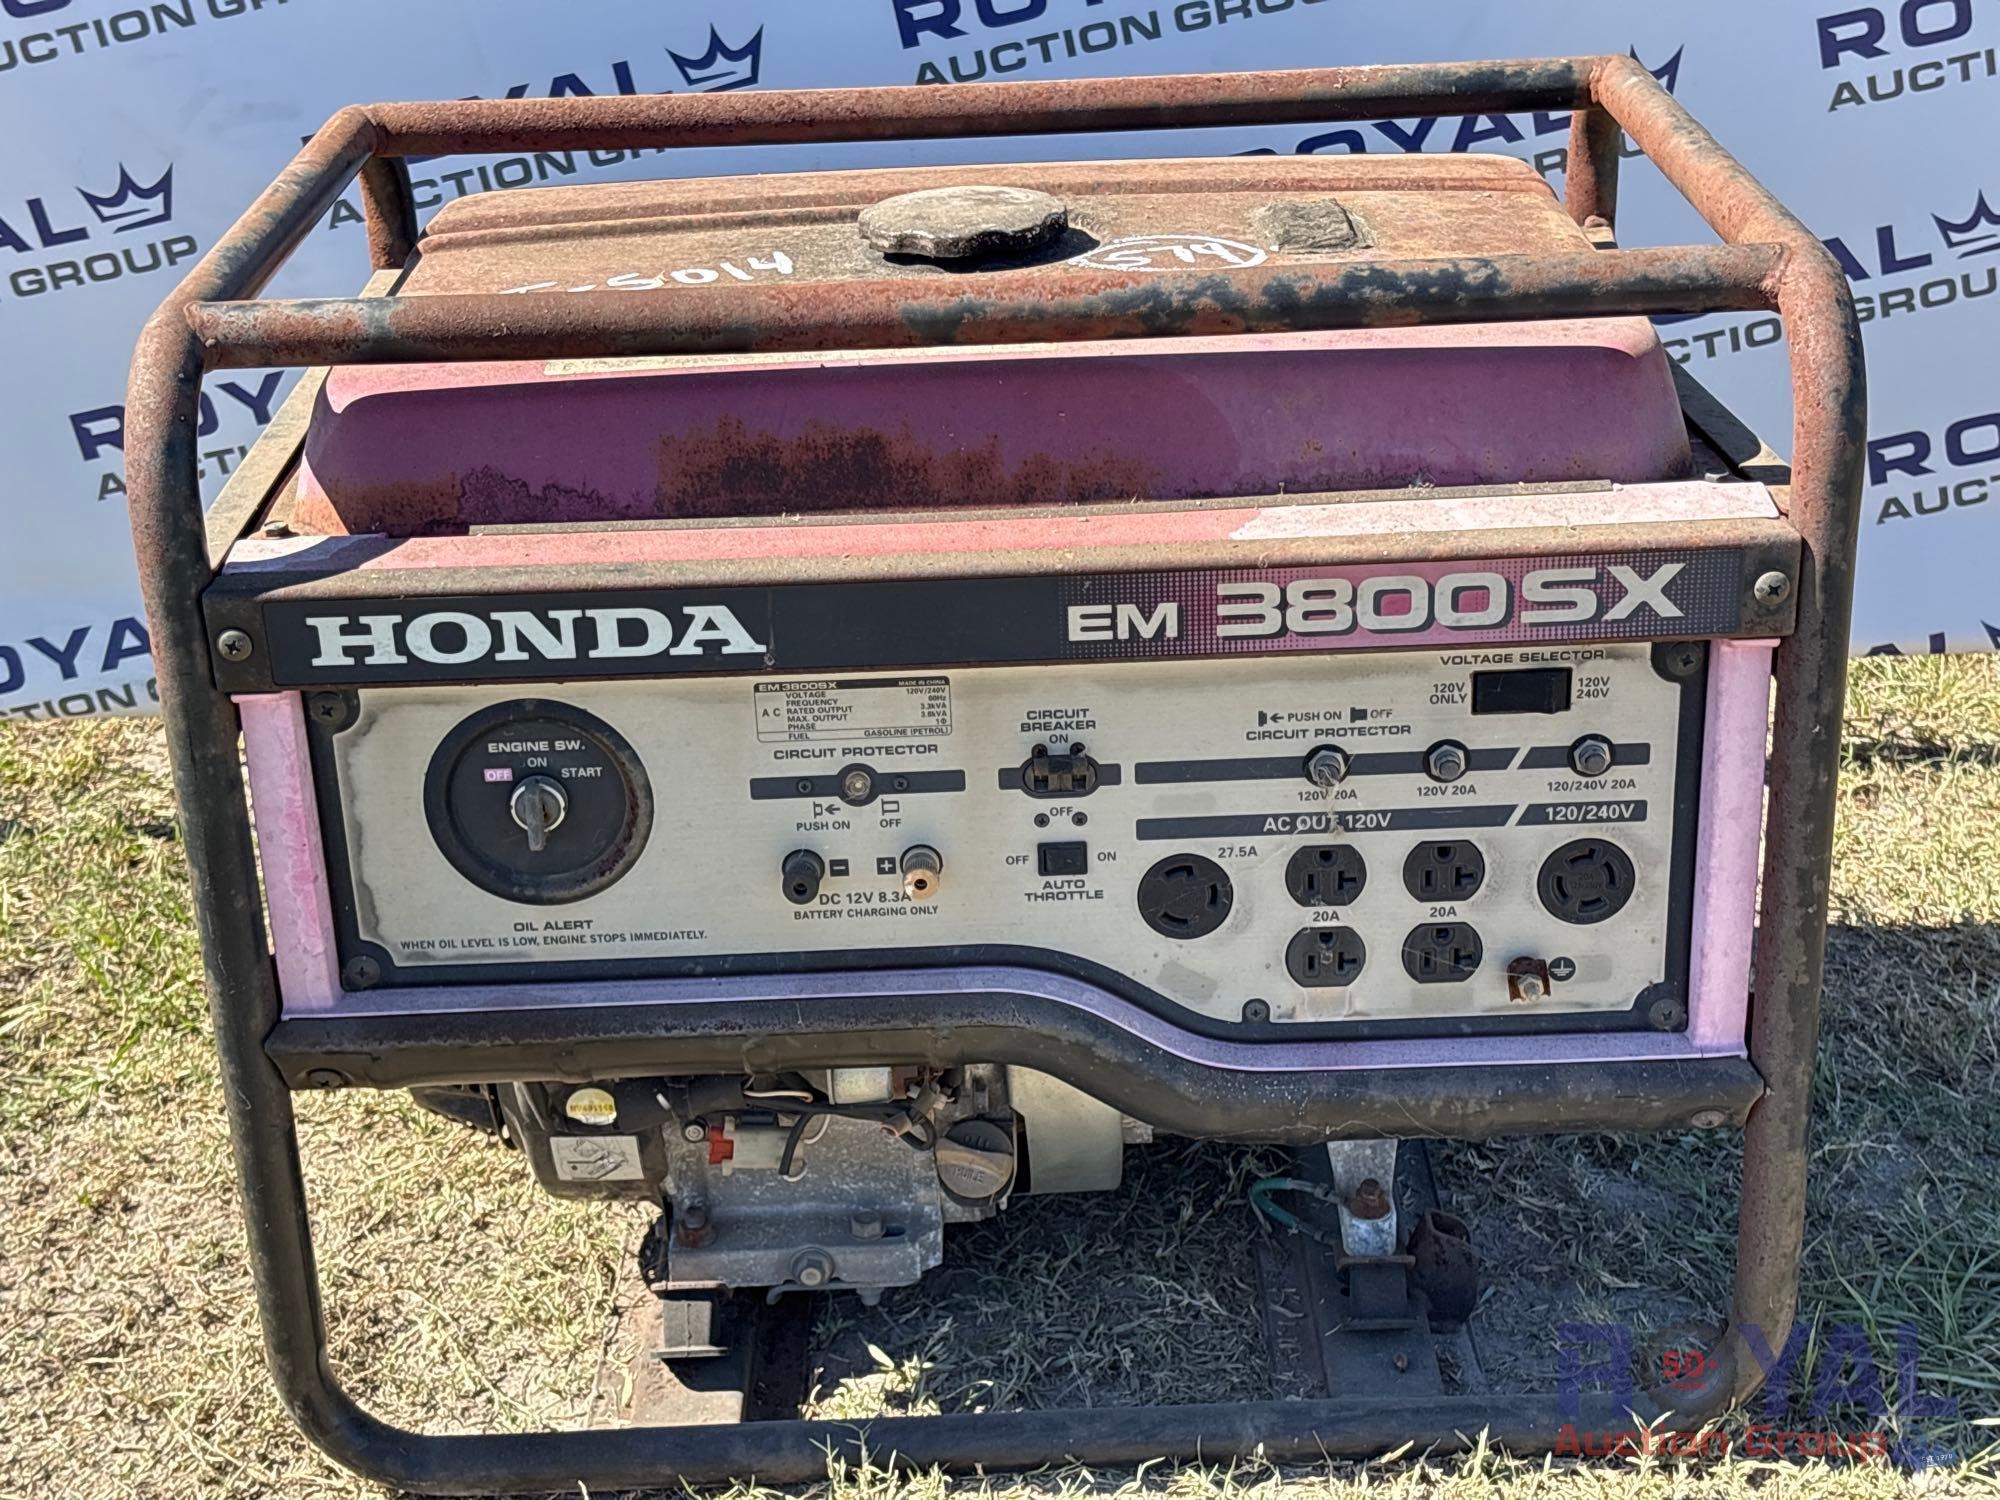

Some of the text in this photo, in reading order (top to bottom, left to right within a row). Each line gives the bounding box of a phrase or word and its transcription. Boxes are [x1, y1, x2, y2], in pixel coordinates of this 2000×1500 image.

[916, 11, 1162, 85] AUCTION
[328, 152, 577, 230] ACTION
[9, 235, 198, 297] GROUP
[1067, 563, 1687, 642] EM 3800SX
[305, 605, 767, 667] HONDA
[1440, 650, 1605, 666] VOLTAGE SELECTOR
[1433, 682, 1466, 693] 120V
[1577, 676, 1610, 688] 120V
[785, 691, 826, 699] VOLTAGE
[906, 687, 946, 695] 120V/240V
[1576, 687, 1610, 699] 240V
[786, 699, 838, 707] FREQUENCY
[1429, 693, 1467, 705] ONLY
[786, 707, 815, 715] RATED
[1026, 708, 1090, 720] CIRCUIT
[1287, 708, 1393, 722] PUSH ON OFF
[813, 714, 848, 722] OUTPUT
[864, 727, 948, 737] GASOLINE (PETROL)
[1020, 720, 1096, 732] BREAKER
[1049, 734, 1069, 744] ON
[1246, 725, 1411, 741] CIRCUIT PROTECTOR
[488, 740, 586, 753] ENGINE SW.
[774, 744, 938, 760] CIRCUIT PROTECTOR
[527, 757, 548, 768] ON
[486, 770, 511, 781] OFF
[561, 767, 602, 778] START
[1417, 784, 1477, 797] 120V 20A
[1547, 779, 1637, 792] 120/240V 20A
[1298, 790, 1329, 801] 120V
[1049, 806, 1074, 817] OFF
[1545, 803, 1636, 822] 120/240V
[796, 820, 851, 832] PUSH ON
[879, 818, 902, 828] OFF
[1263, 816, 1291, 832] AC
[1345, 812, 1392, 829] 120V
[1097, 852, 1117, 861] ON
[1218, 846, 1257, 858] 27.5A
[1005, 855, 1030, 865] OFF
[1042, 879, 1085, 890] AUTO
[819, 891, 912, 905] DC 12V 8.3A
[1024, 890, 1104, 902] THROTTLE
[793, 905, 939, 920] BATTERY CHARGING ONLY
[1312, 911, 1341, 922] 20A
[1429, 906, 1457, 918] 20A
[513, 920, 594, 932] OIL ALERT
[400, 930, 708, 950] WHEN OIL LEVEL IS LOW, ENGINE STOPS IMMEDIATELY.
